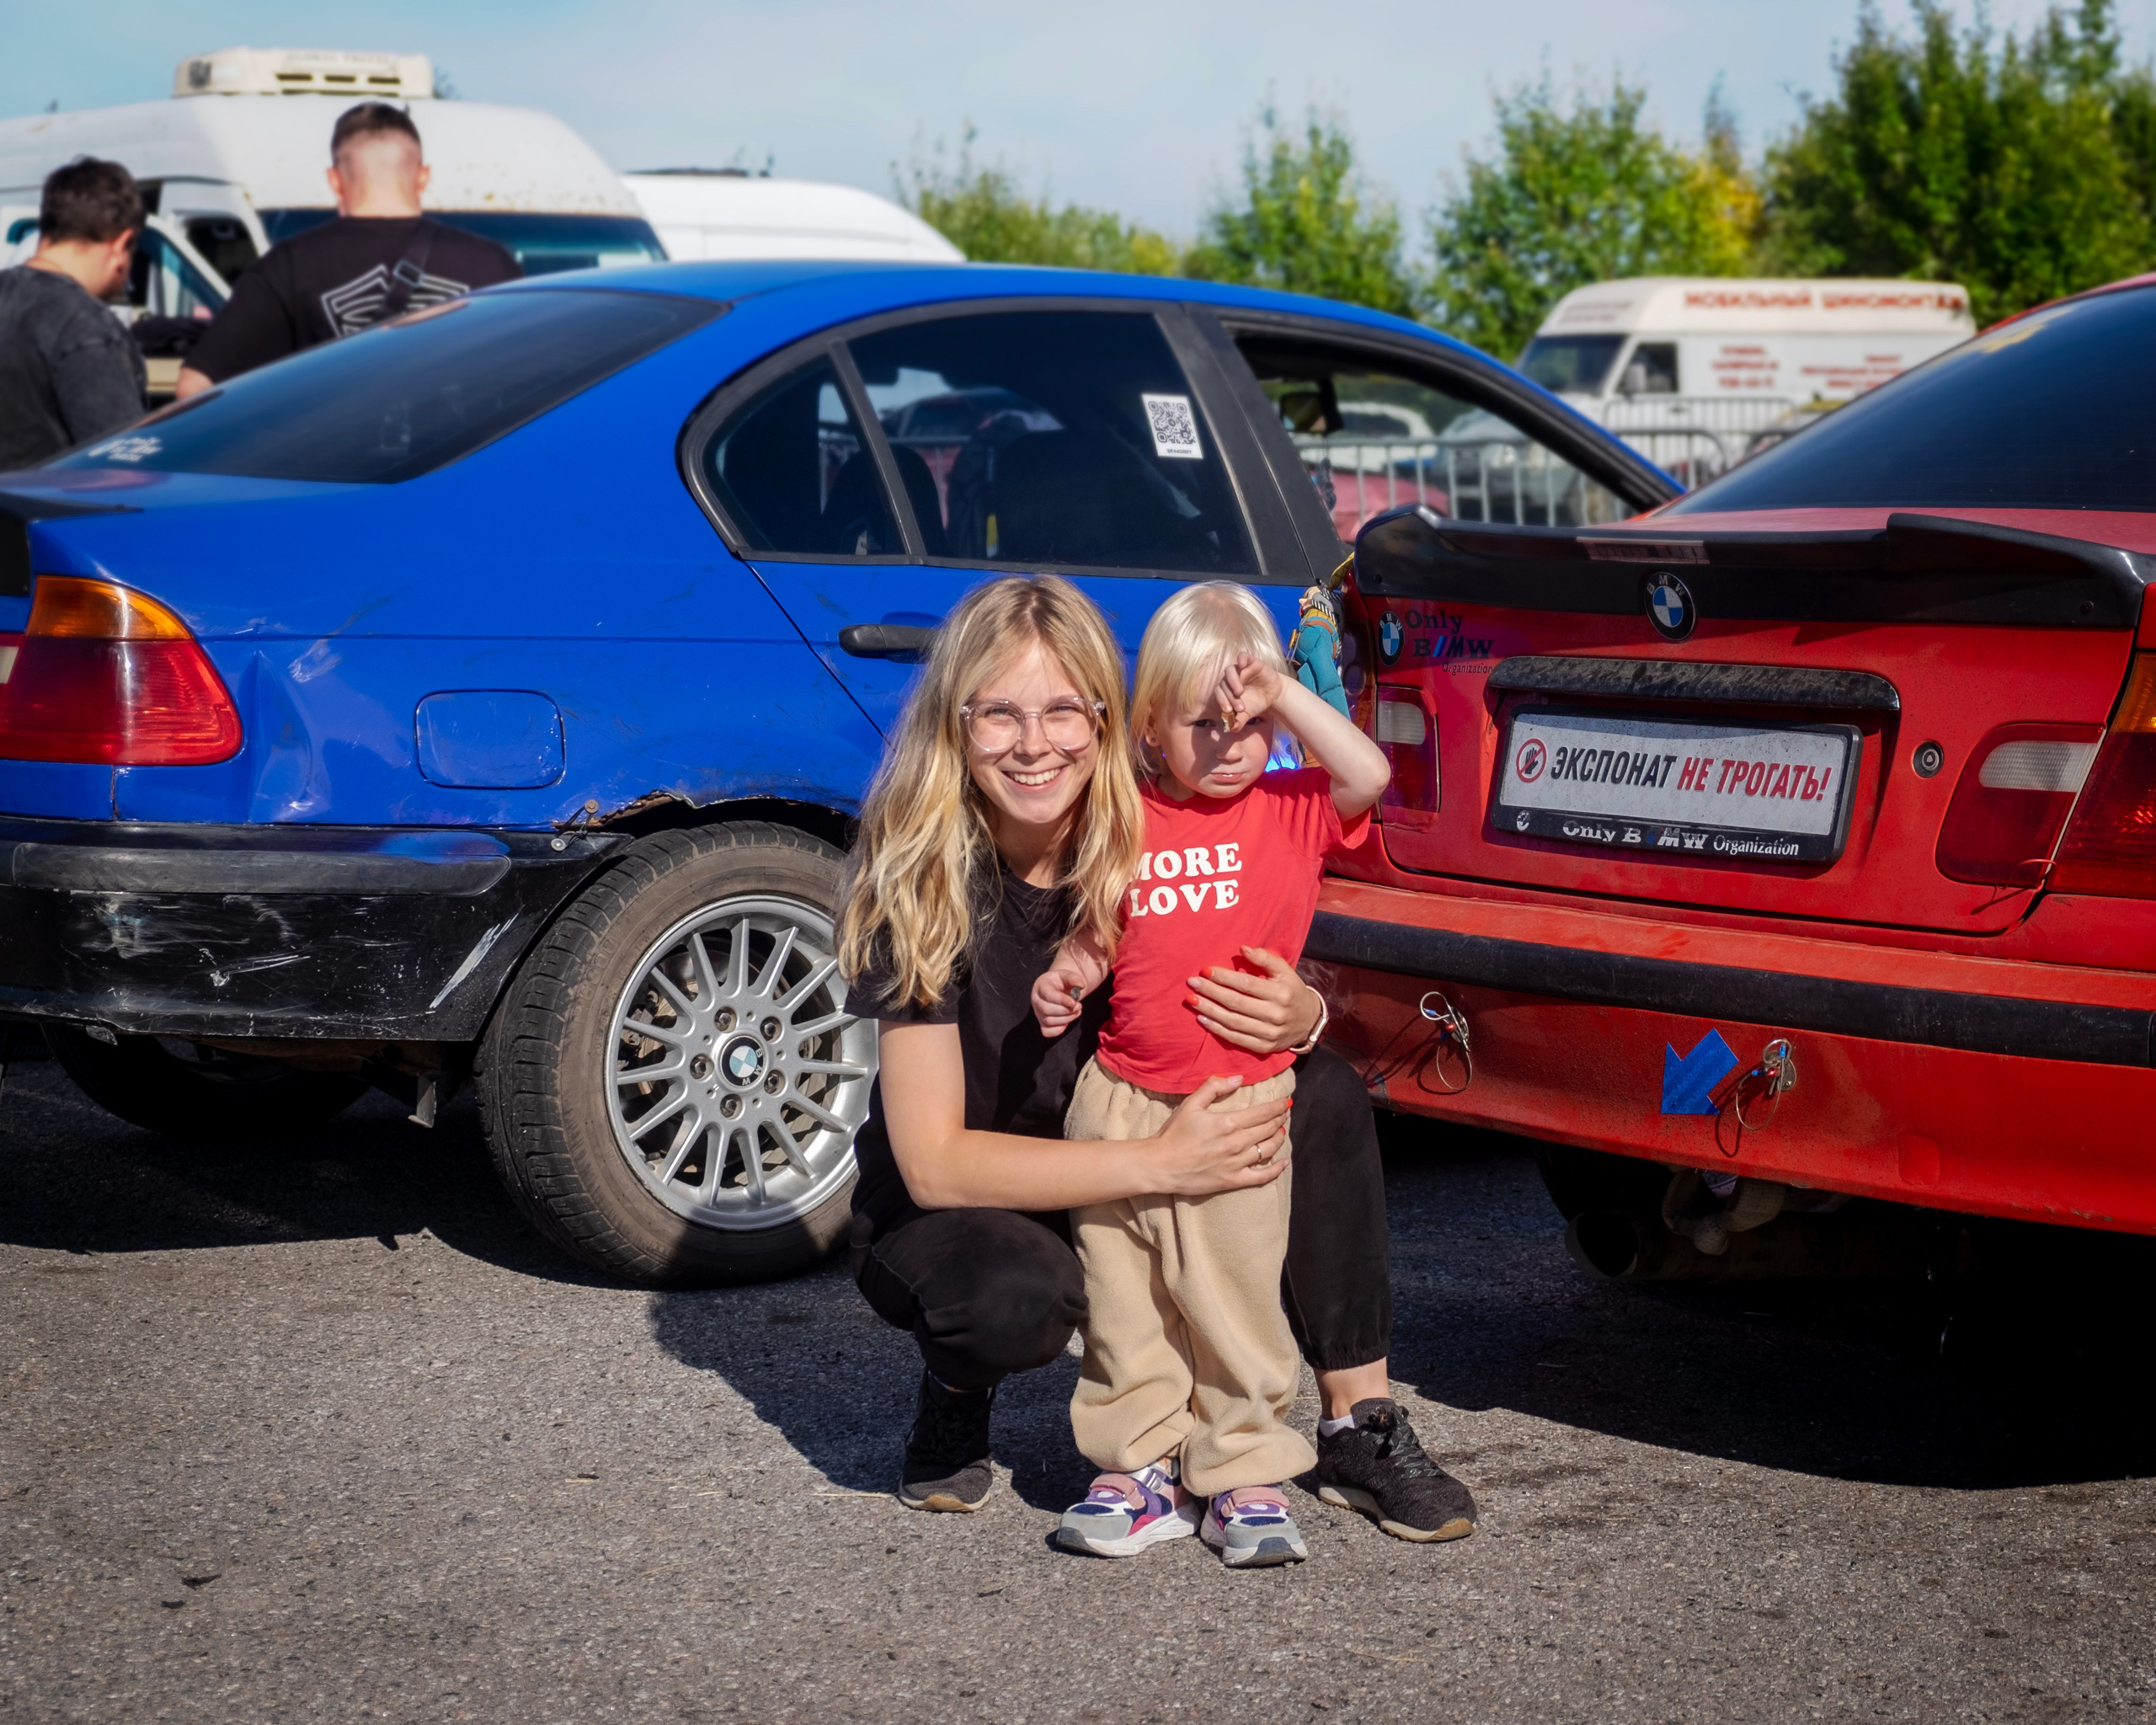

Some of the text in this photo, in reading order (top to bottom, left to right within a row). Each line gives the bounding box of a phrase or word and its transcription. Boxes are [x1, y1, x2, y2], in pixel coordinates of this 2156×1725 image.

[1646, 574, 1686, 596] BMW
[1405, 609, 1463, 634] Only
[1550, 746, 1833, 803] ЭКСПОНАТ НЕ ТРОГАТЬ!
[1562, 820, 1616, 843] Only
[1713, 834, 1800, 856] Organization
[1129, 879, 1240, 917] LOVE
